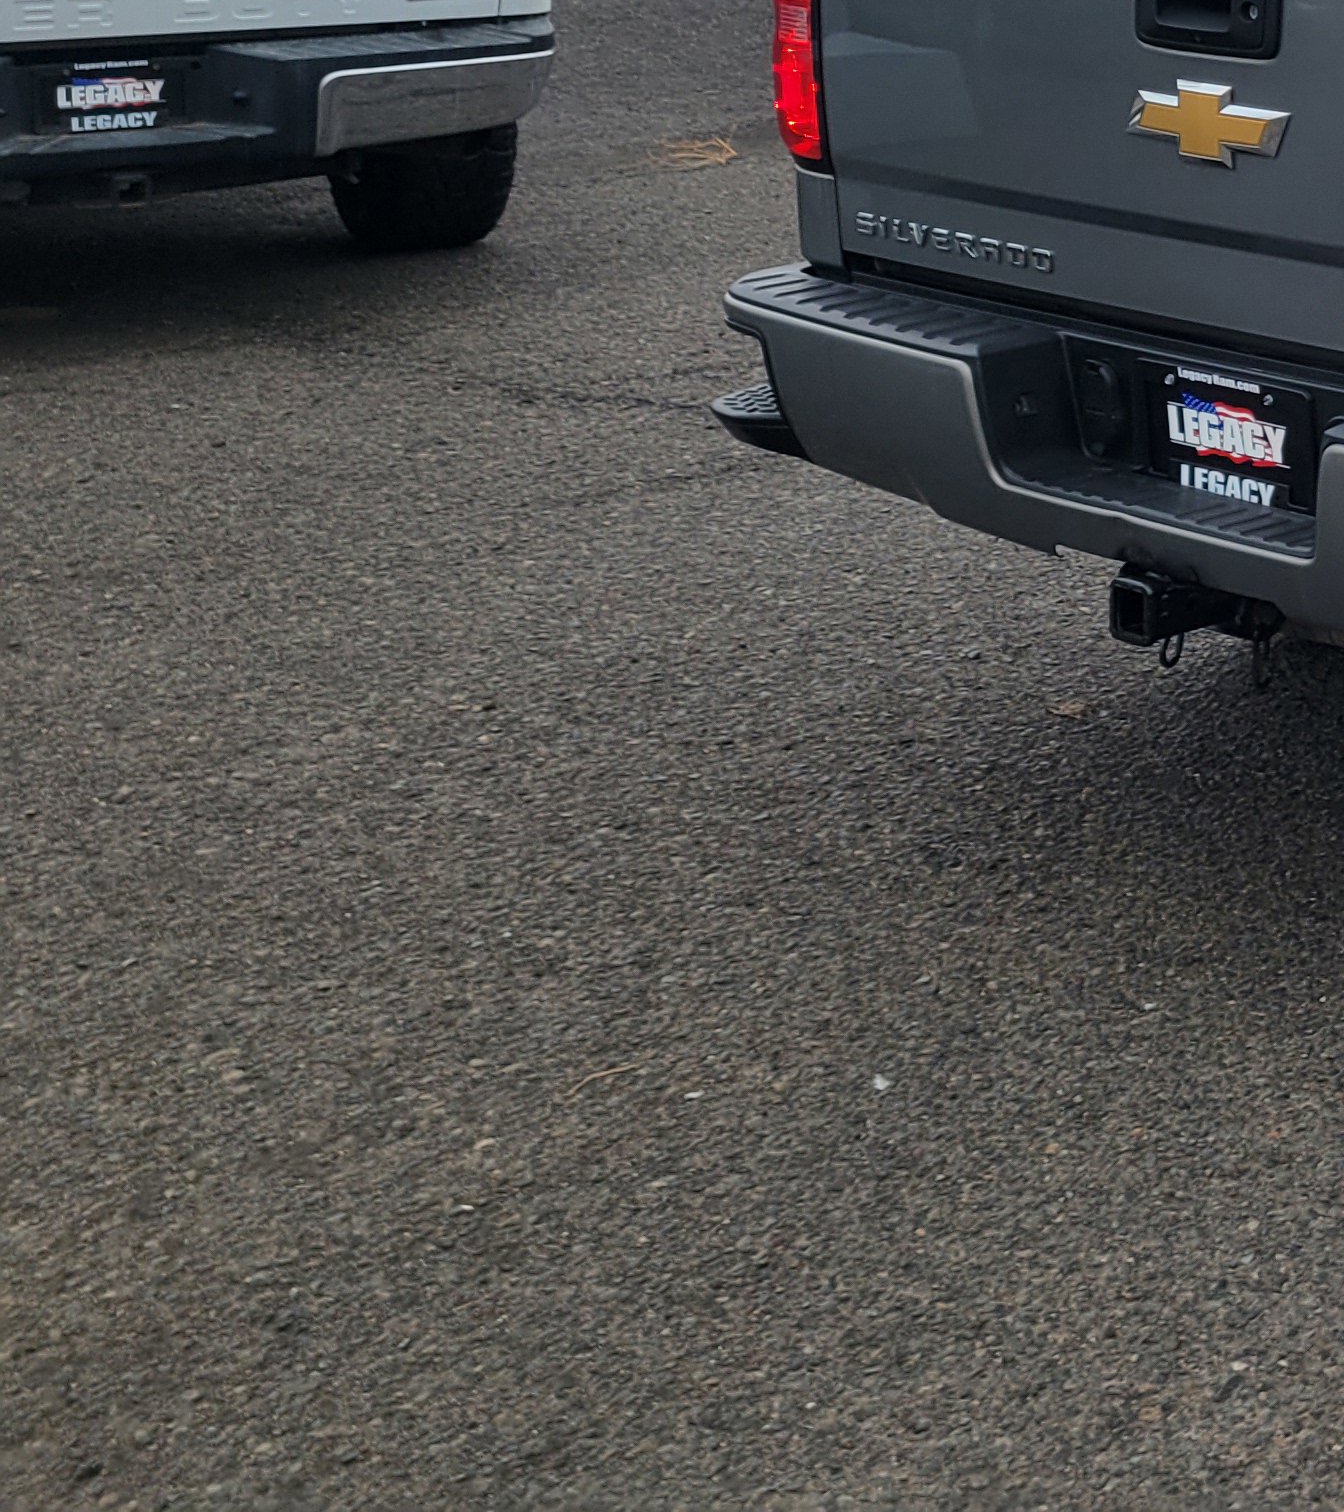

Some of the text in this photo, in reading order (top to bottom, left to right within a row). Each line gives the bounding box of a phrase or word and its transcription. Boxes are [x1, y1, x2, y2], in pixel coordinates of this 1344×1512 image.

[57, 78, 165, 108] LEGACY
[71, 111, 157, 132] LEGACY
[856, 210, 1056, 273] SILVERADO
[1167, 403, 1287, 464] LEGACY
[1180, 463, 1275, 507] LEGACY
